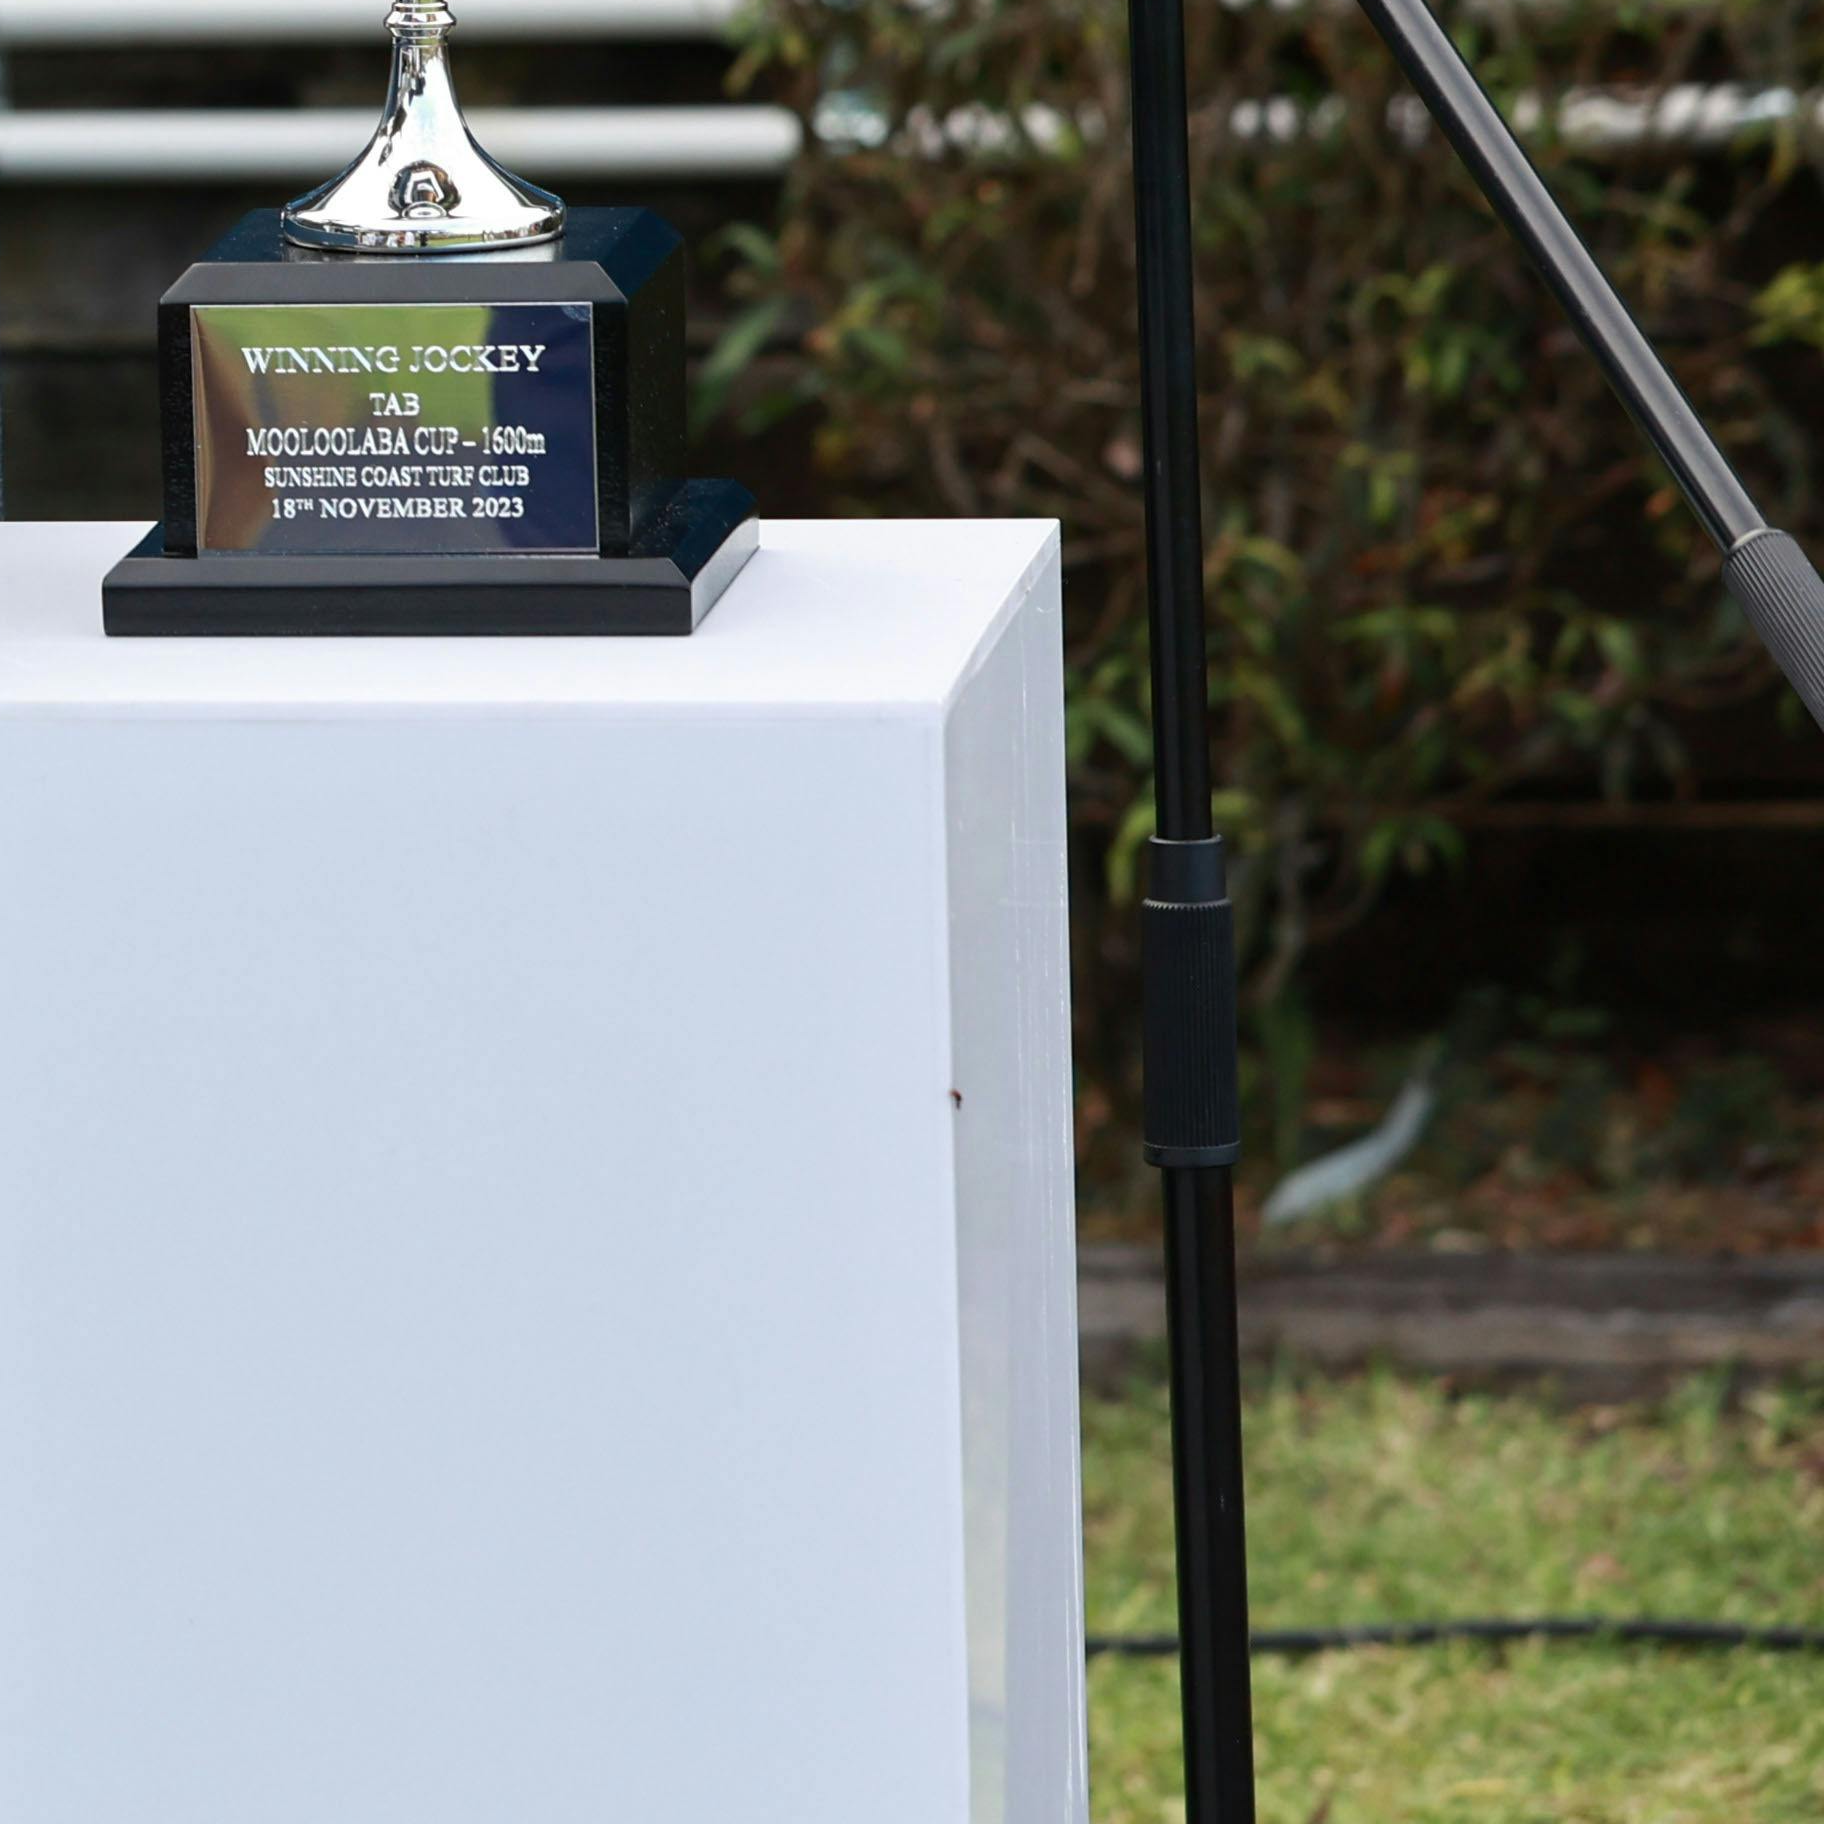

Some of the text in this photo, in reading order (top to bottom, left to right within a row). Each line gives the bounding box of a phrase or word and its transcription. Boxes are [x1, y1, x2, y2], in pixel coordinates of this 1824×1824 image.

[241, 344, 546, 374] WINNING JOCKEY
[369, 392, 420, 417] TAB
[246, 427, 410, 456] MOOLOOLABA
[414, 427, 458, 455] CUP
[482, 426, 546, 455] 1600m
[264, 465, 530, 488] SUNSHINE COAST TURF CLUB
[320, 497, 466, 518] NOVEMBER
[472, 497, 524, 518] 2023
